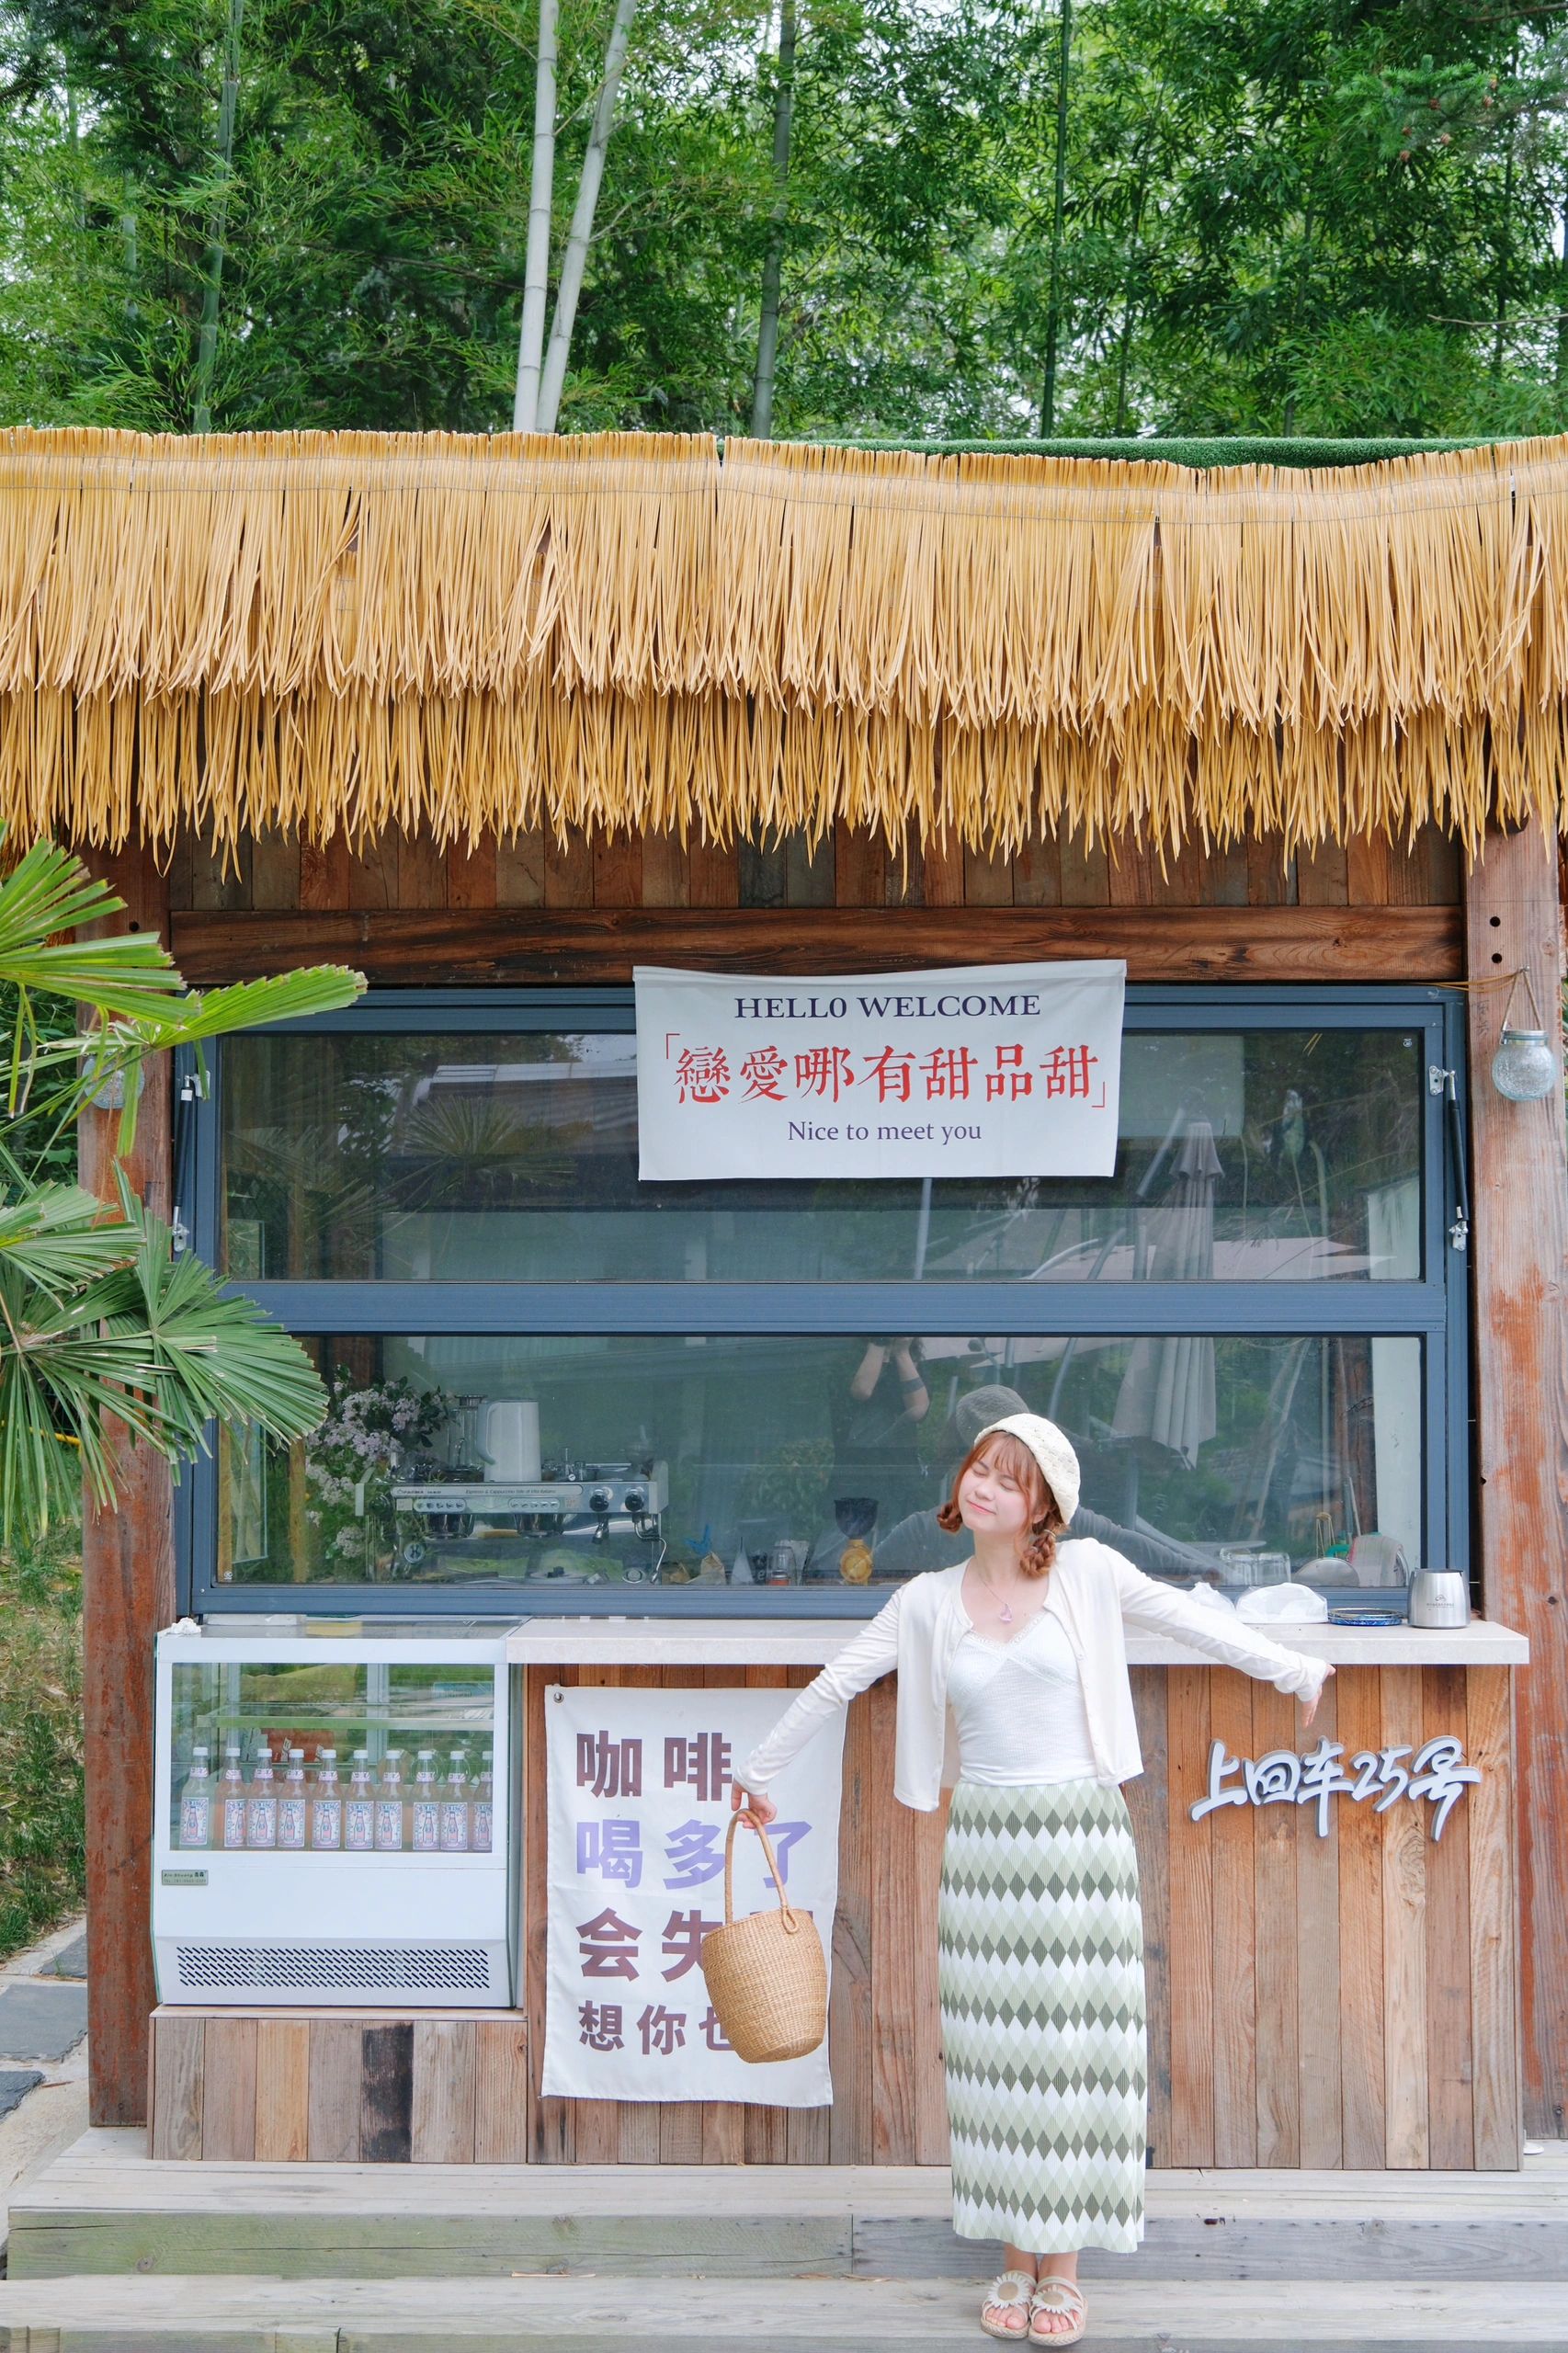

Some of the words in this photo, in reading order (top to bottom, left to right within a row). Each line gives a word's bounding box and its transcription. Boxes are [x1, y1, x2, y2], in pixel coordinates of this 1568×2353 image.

[857, 995, 1040, 1017] WELCOME
[788, 1120, 838, 1142] Nice
[846, 1123, 869, 1141] to
[876, 1122, 934, 1141] meet
[941, 1125, 982, 1145] you
[575, 1730, 733, 1801] 咖啡
[1188, 1735, 1483, 1842] 上回车25号
[575, 1818, 812, 1891] 喝多了
[575, 1907, 813, 1983] 会失
